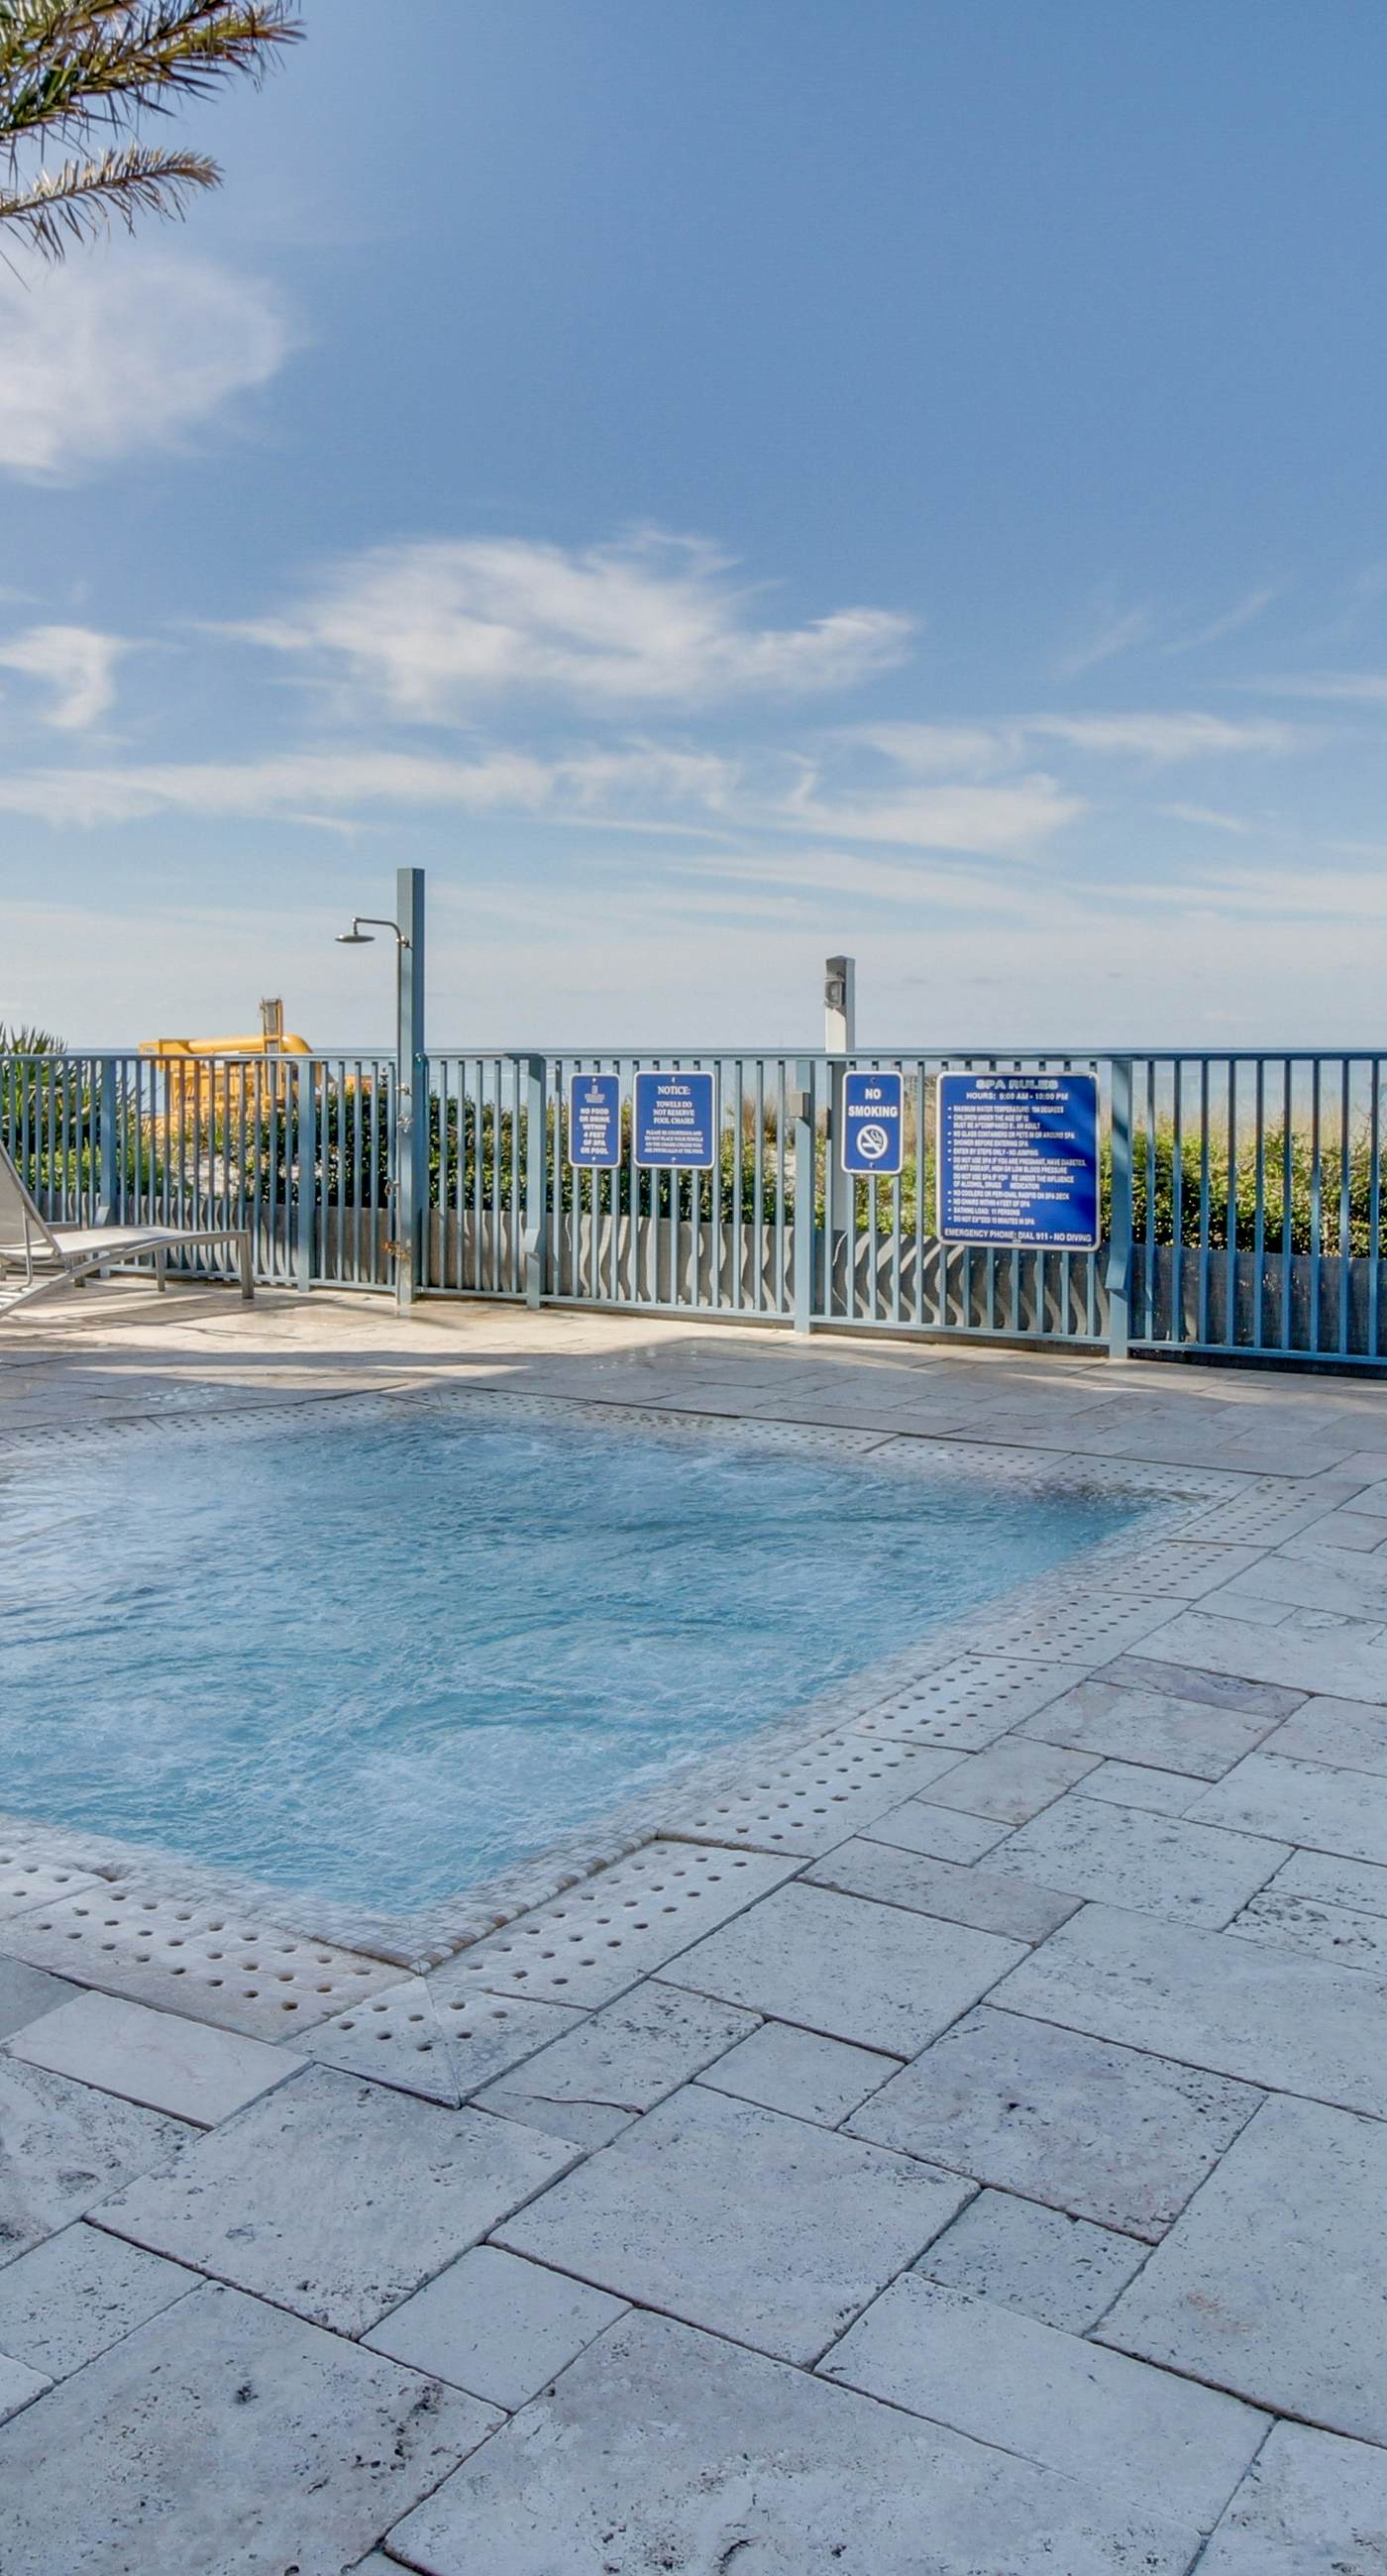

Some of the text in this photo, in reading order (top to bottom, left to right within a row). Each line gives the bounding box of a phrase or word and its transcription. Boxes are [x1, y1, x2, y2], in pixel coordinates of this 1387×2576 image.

[658, 1086, 691, 1095] NOTICE:
[976, 1079, 1058, 1090] SPA RULES
[865, 1088, 882, 1100] NO
[848, 1106, 898, 1118] SMOKING
[944, 1229, 989, 1237] EMERGENCY
[990, 1230, 1016, 1238] PHONE:
[1018, 1232, 1034, 1240] DIAL
[1054, 1233, 1065, 1241] NO
[1066, 1234, 1092, 1242] DIVING
